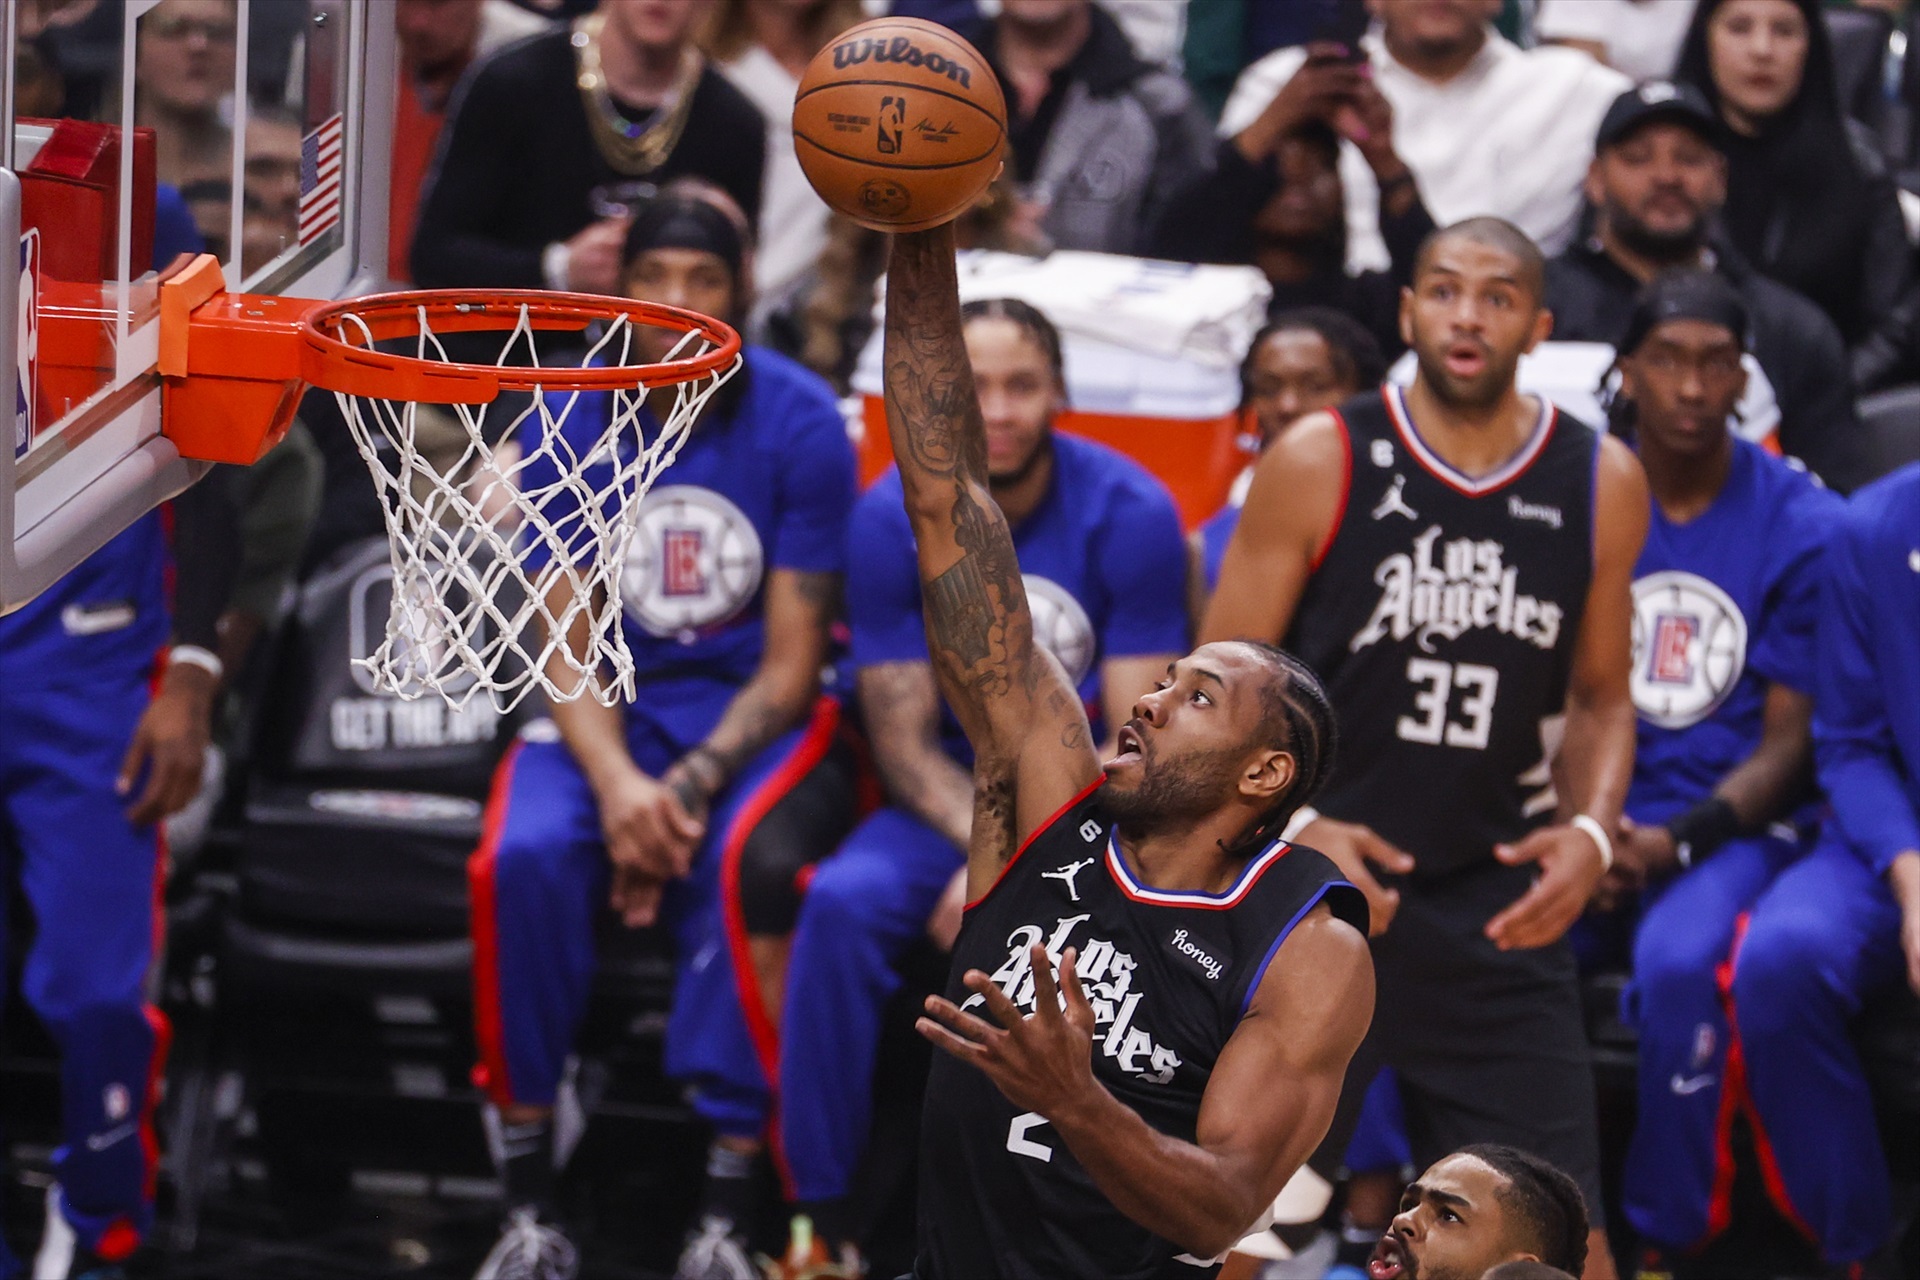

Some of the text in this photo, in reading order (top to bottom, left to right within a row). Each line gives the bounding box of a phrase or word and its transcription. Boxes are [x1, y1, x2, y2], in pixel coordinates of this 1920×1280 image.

[833, 36, 971, 89] Wilson
[1412, 523, 1504, 587] Los
[1350, 552, 1564, 653] Angeles
[1396, 656, 1499, 750] 33
[1079, 818, 1103, 843] 6
[1046, 913, 1139, 1003] Los
[1171, 928, 1225, 981] honey
